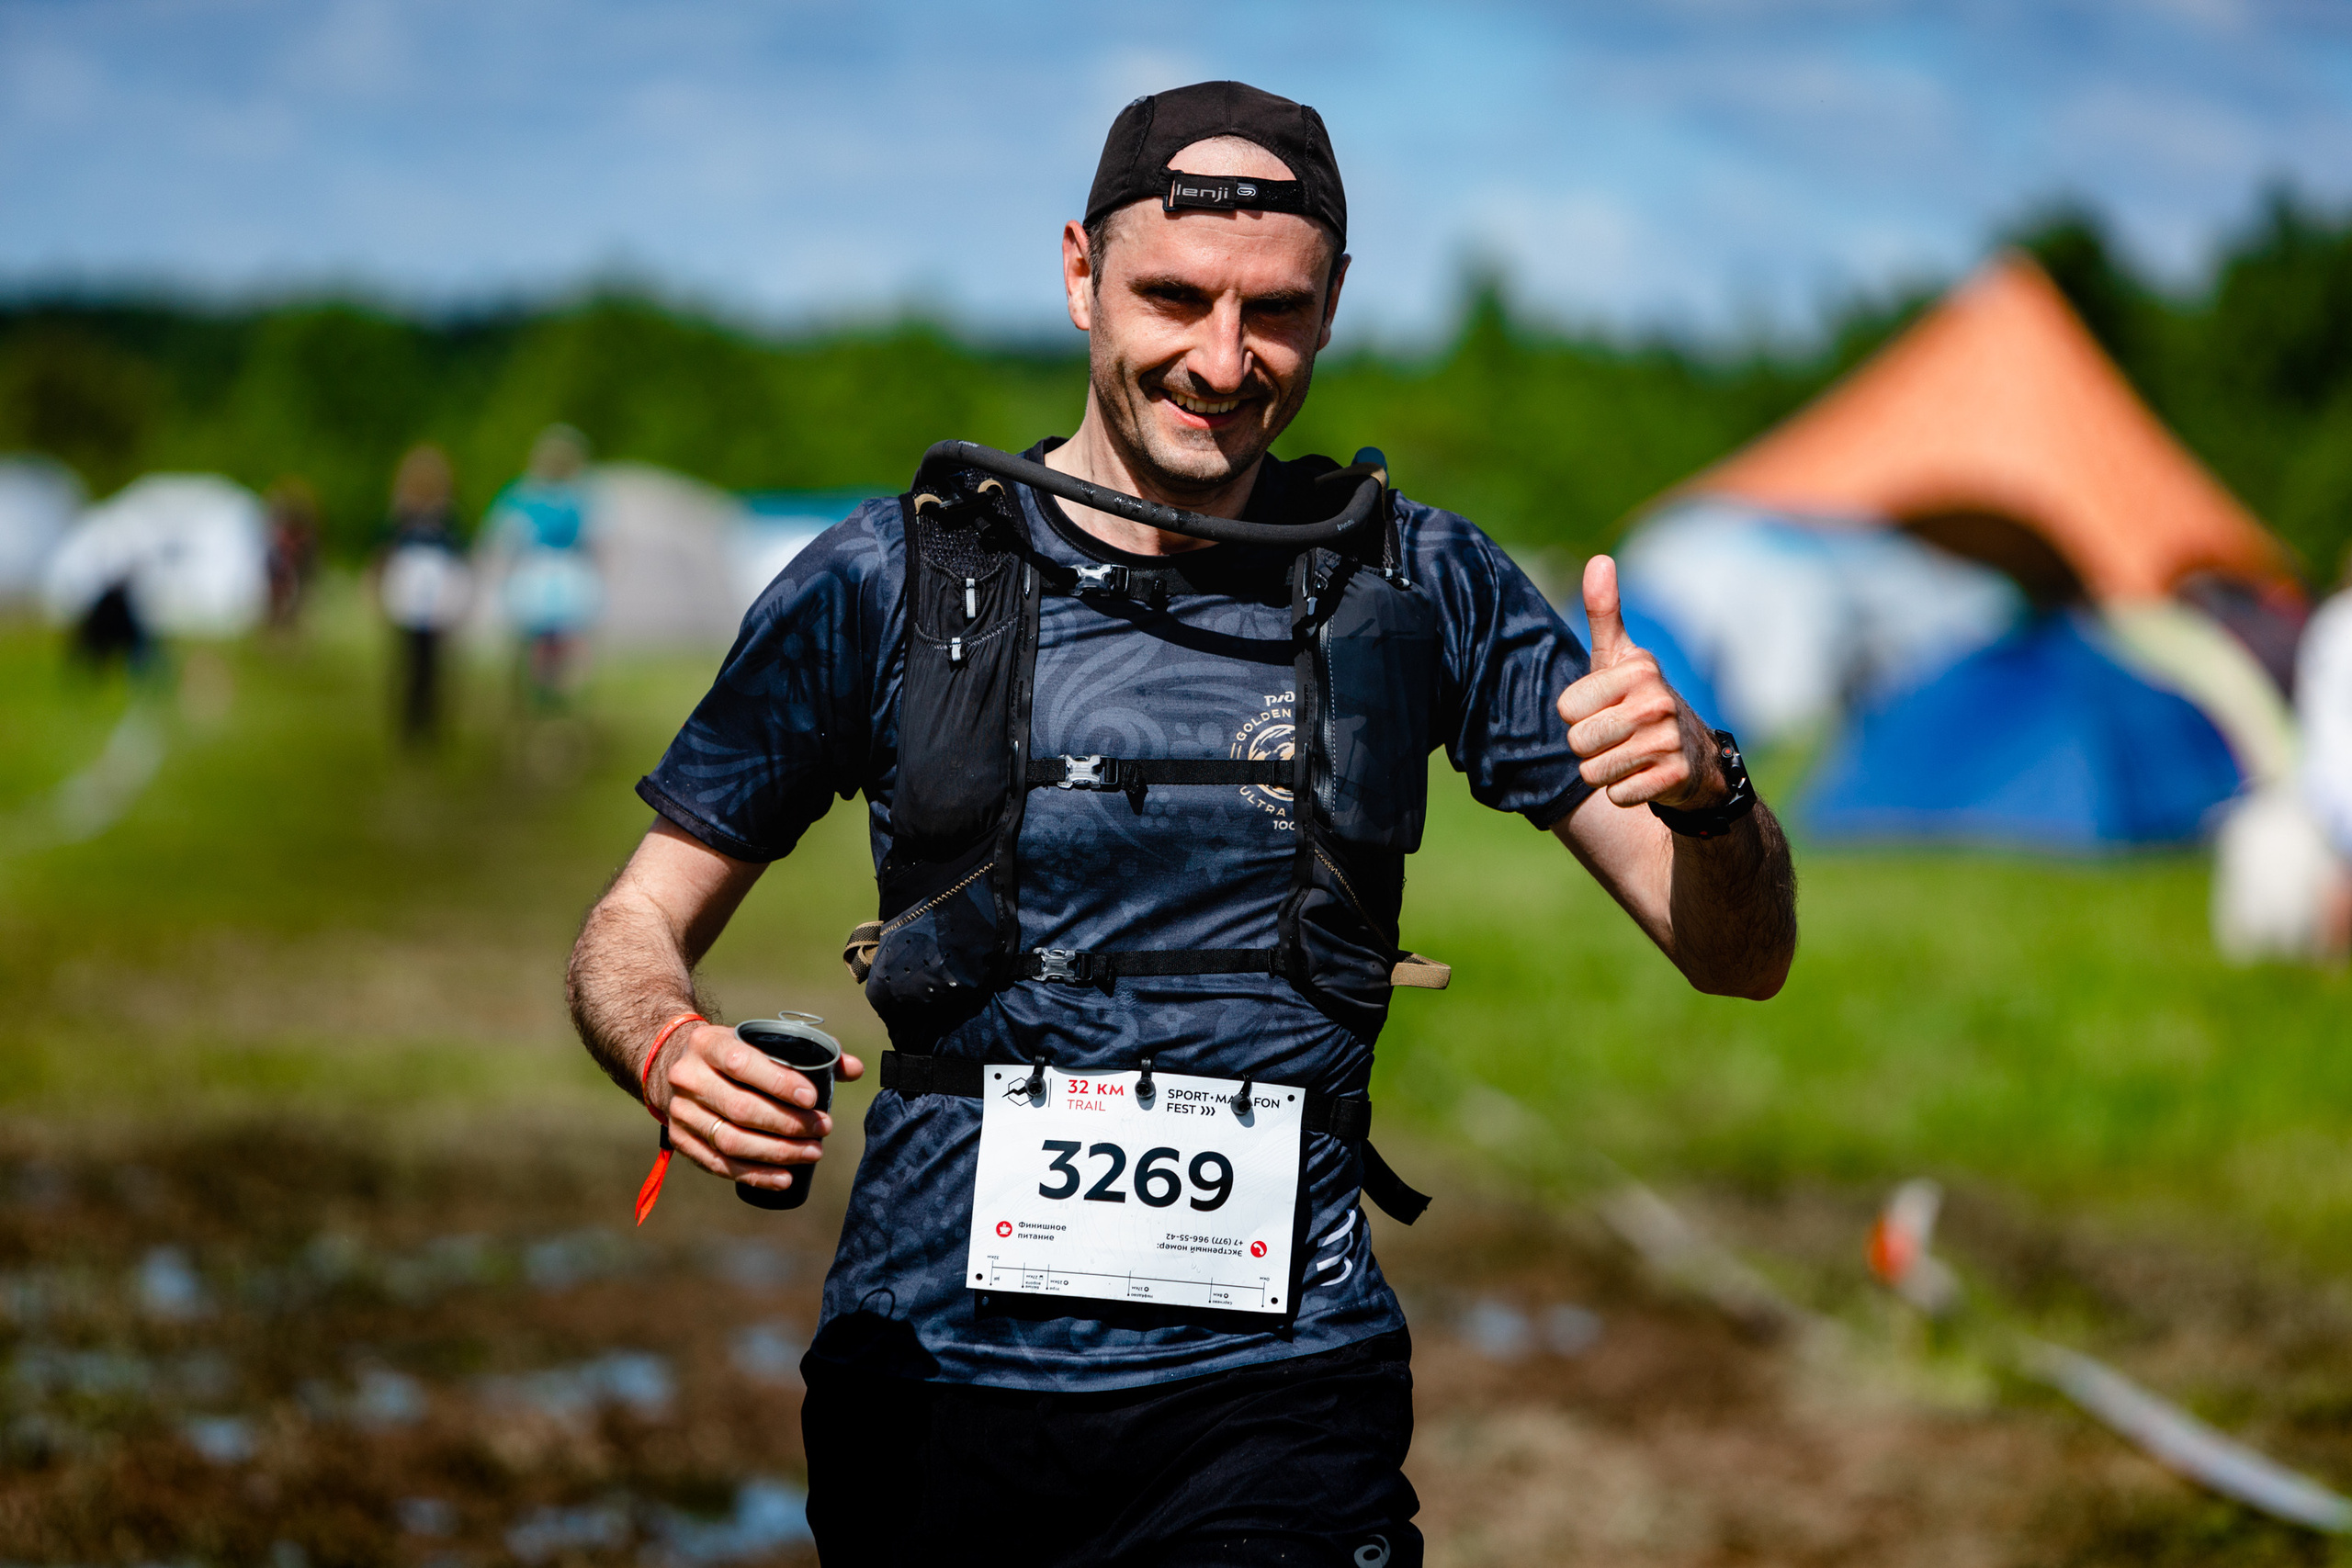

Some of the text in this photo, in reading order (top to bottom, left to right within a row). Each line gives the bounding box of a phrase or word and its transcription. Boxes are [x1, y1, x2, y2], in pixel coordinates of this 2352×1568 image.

[1236, 708, 1292, 742] GOLDEN
[1239, 785, 1286, 818] ULTRA
[1068, 1079, 1089, 1094] 32
[1067, 1099, 1106, 1111] TRAIL
[1166, 1102, 1197, 1114] FEST
[1038, 1139, 1234, 1213] 3269
[1018, 1221, 1067, 1232] Финишное
[1017, 1233, 1055, 1241] питание
[1166, 1233, 1209, 1244] 966-55-42
[1211, 1236, 1232, 1246] (977)
[1157, 1242, 1243, 1257] Экстренный номер:
